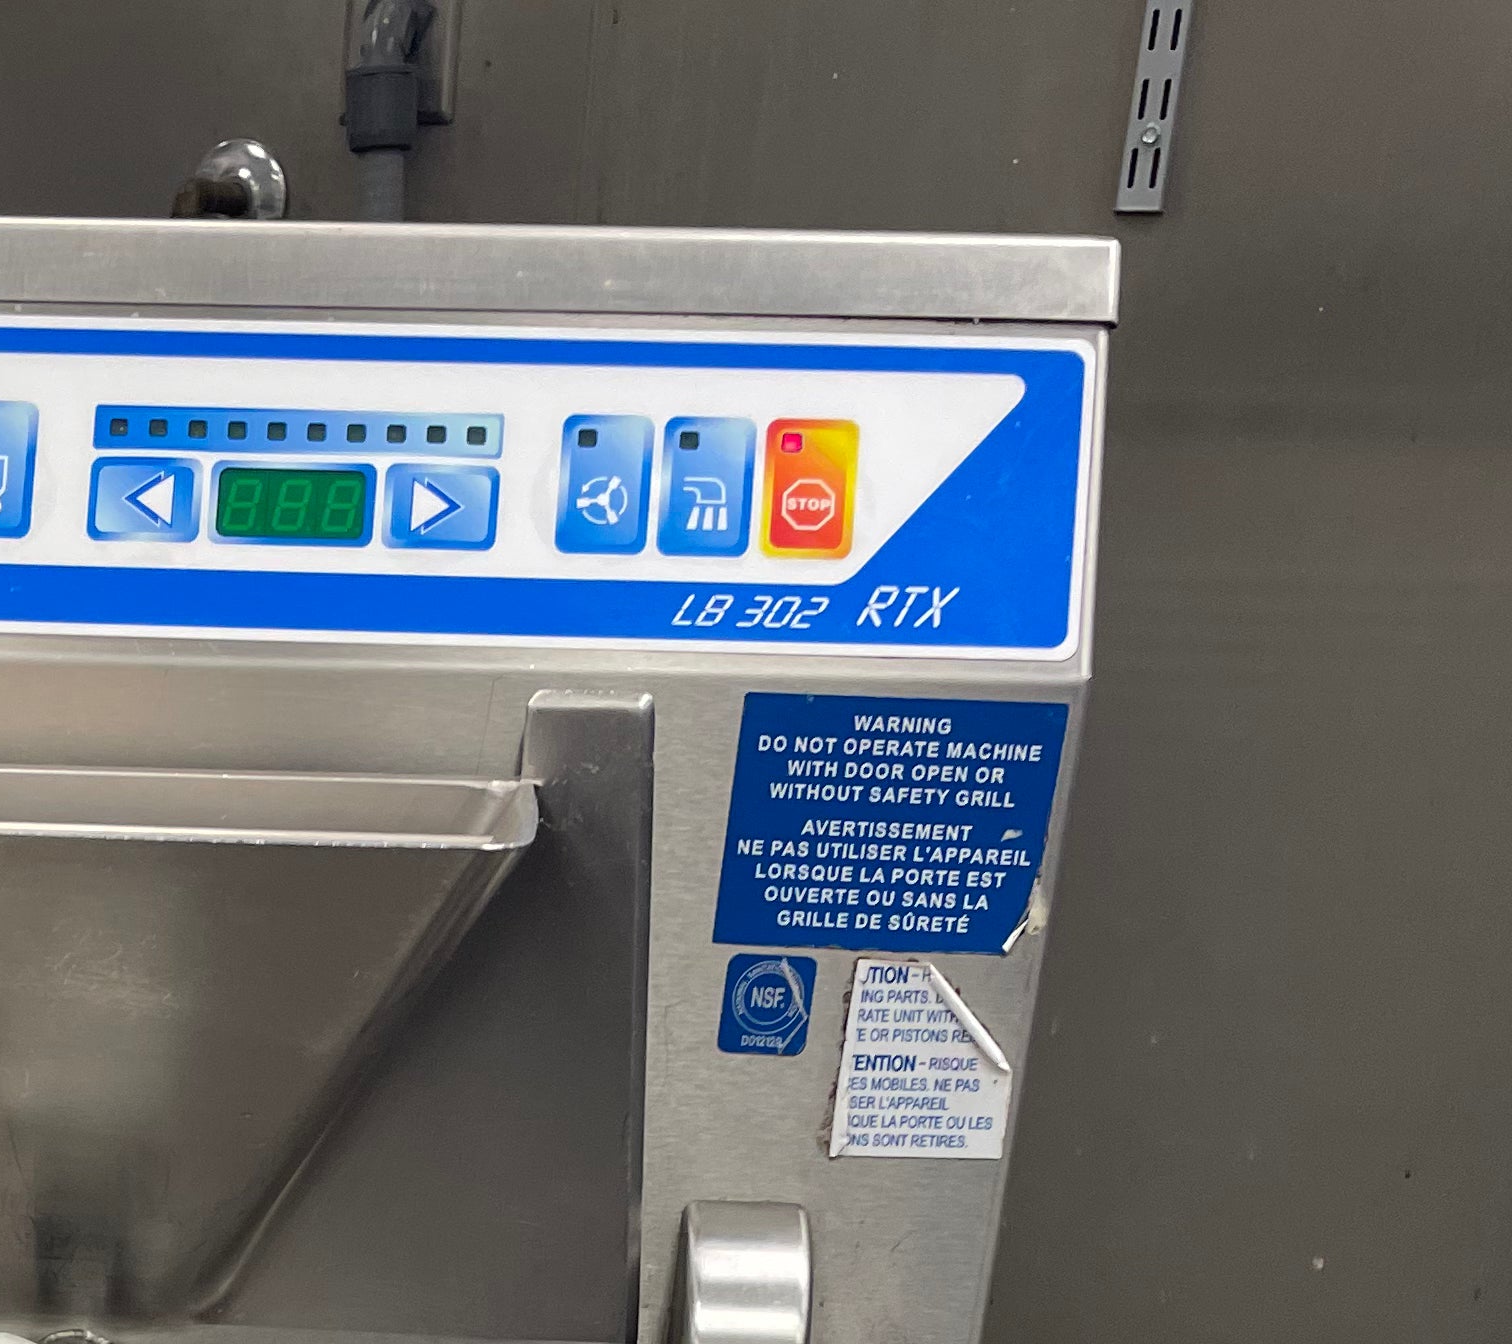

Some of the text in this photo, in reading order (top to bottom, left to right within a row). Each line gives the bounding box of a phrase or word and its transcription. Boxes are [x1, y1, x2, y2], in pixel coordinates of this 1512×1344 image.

[787, 497, 831, 511] STOP
[671, 585, 960, 629] LB 302 RTX
[854, 715, 952, 735] WARNING
[758, 735, 1042, 762] DO NOT OPERATE MACHINE
[788, 760, 1005, 784] WITH DOOR OPEN OR
[770, 782, 1015, 808] WITHOUT SAFETY GRILL
[801, 819, 972, 841] AVERTISSEMENT
[737, 839, 1031, 867] NE PAS UTILISER L'APPAREIL
[755, 863, 1006, 888] LORSQUE LA PORTE EST
[764, 885, 989, 910] OUVERTE OU SANS LA
[777, 910, 970, 934] GRILLE DE SÛRETÉ
[893, 1009, 923, 1023] UNIT
[870, 1028, 889, 1042] OR
[892, 1028, 948, 1043] PISTONS
[928, 1057, 979, 1072] RISQUE
[933, 1078, 953, 1092] NE
[954, 1078, 980, 1092] PAS
[881, 1115, 896, 1129] LA
[899, 1115, 943, 1130] PORTE
[946, 1116, 966, 1130] OU
[968, 1116, 993, 1131] LES
[872, 1134, 908, 1147] SONT
